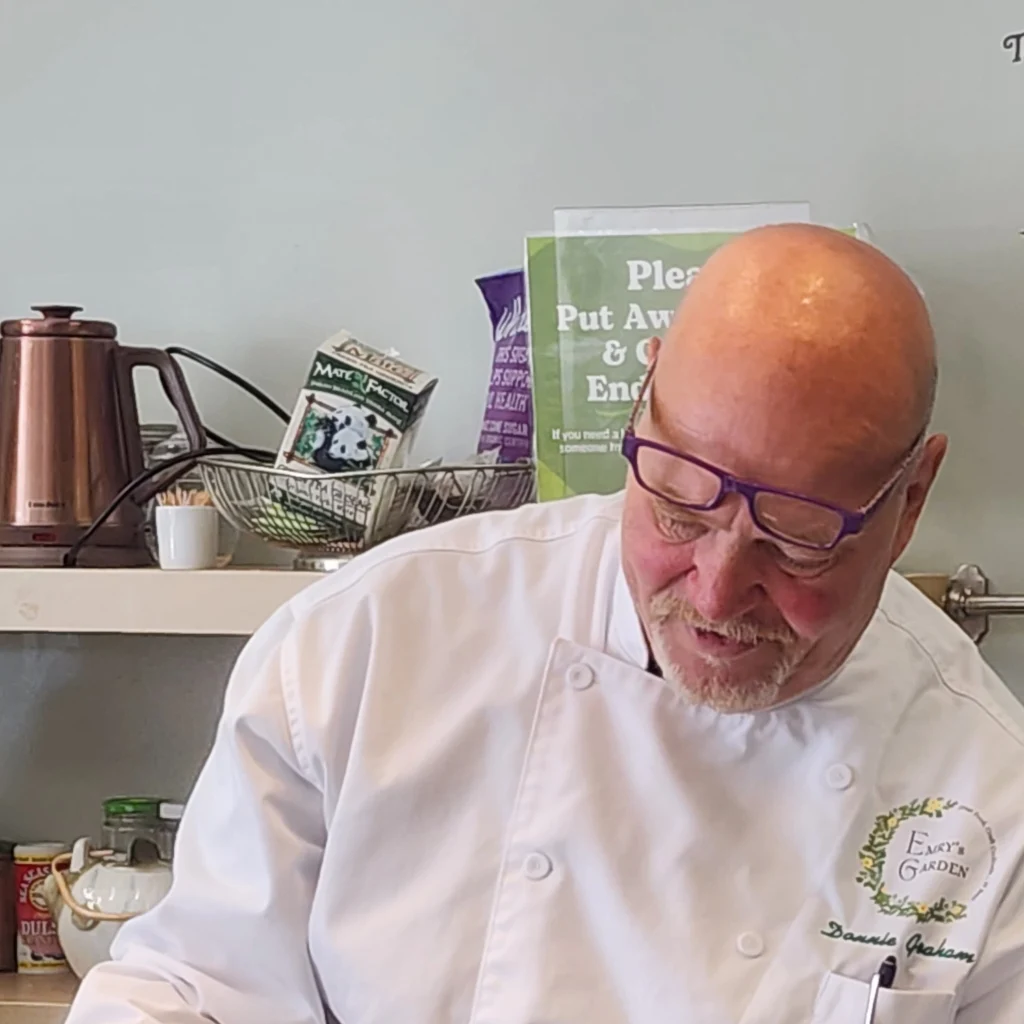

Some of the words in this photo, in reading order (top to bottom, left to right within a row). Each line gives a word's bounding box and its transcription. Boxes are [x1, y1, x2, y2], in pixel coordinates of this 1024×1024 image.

[556, 303, 614, 331] Put
[602, 340, 627, 366] &
[562, 430, 581, 441] you
[898, 857, 970, 882] GARDEN
[905, 933, 978, 963] Graham
